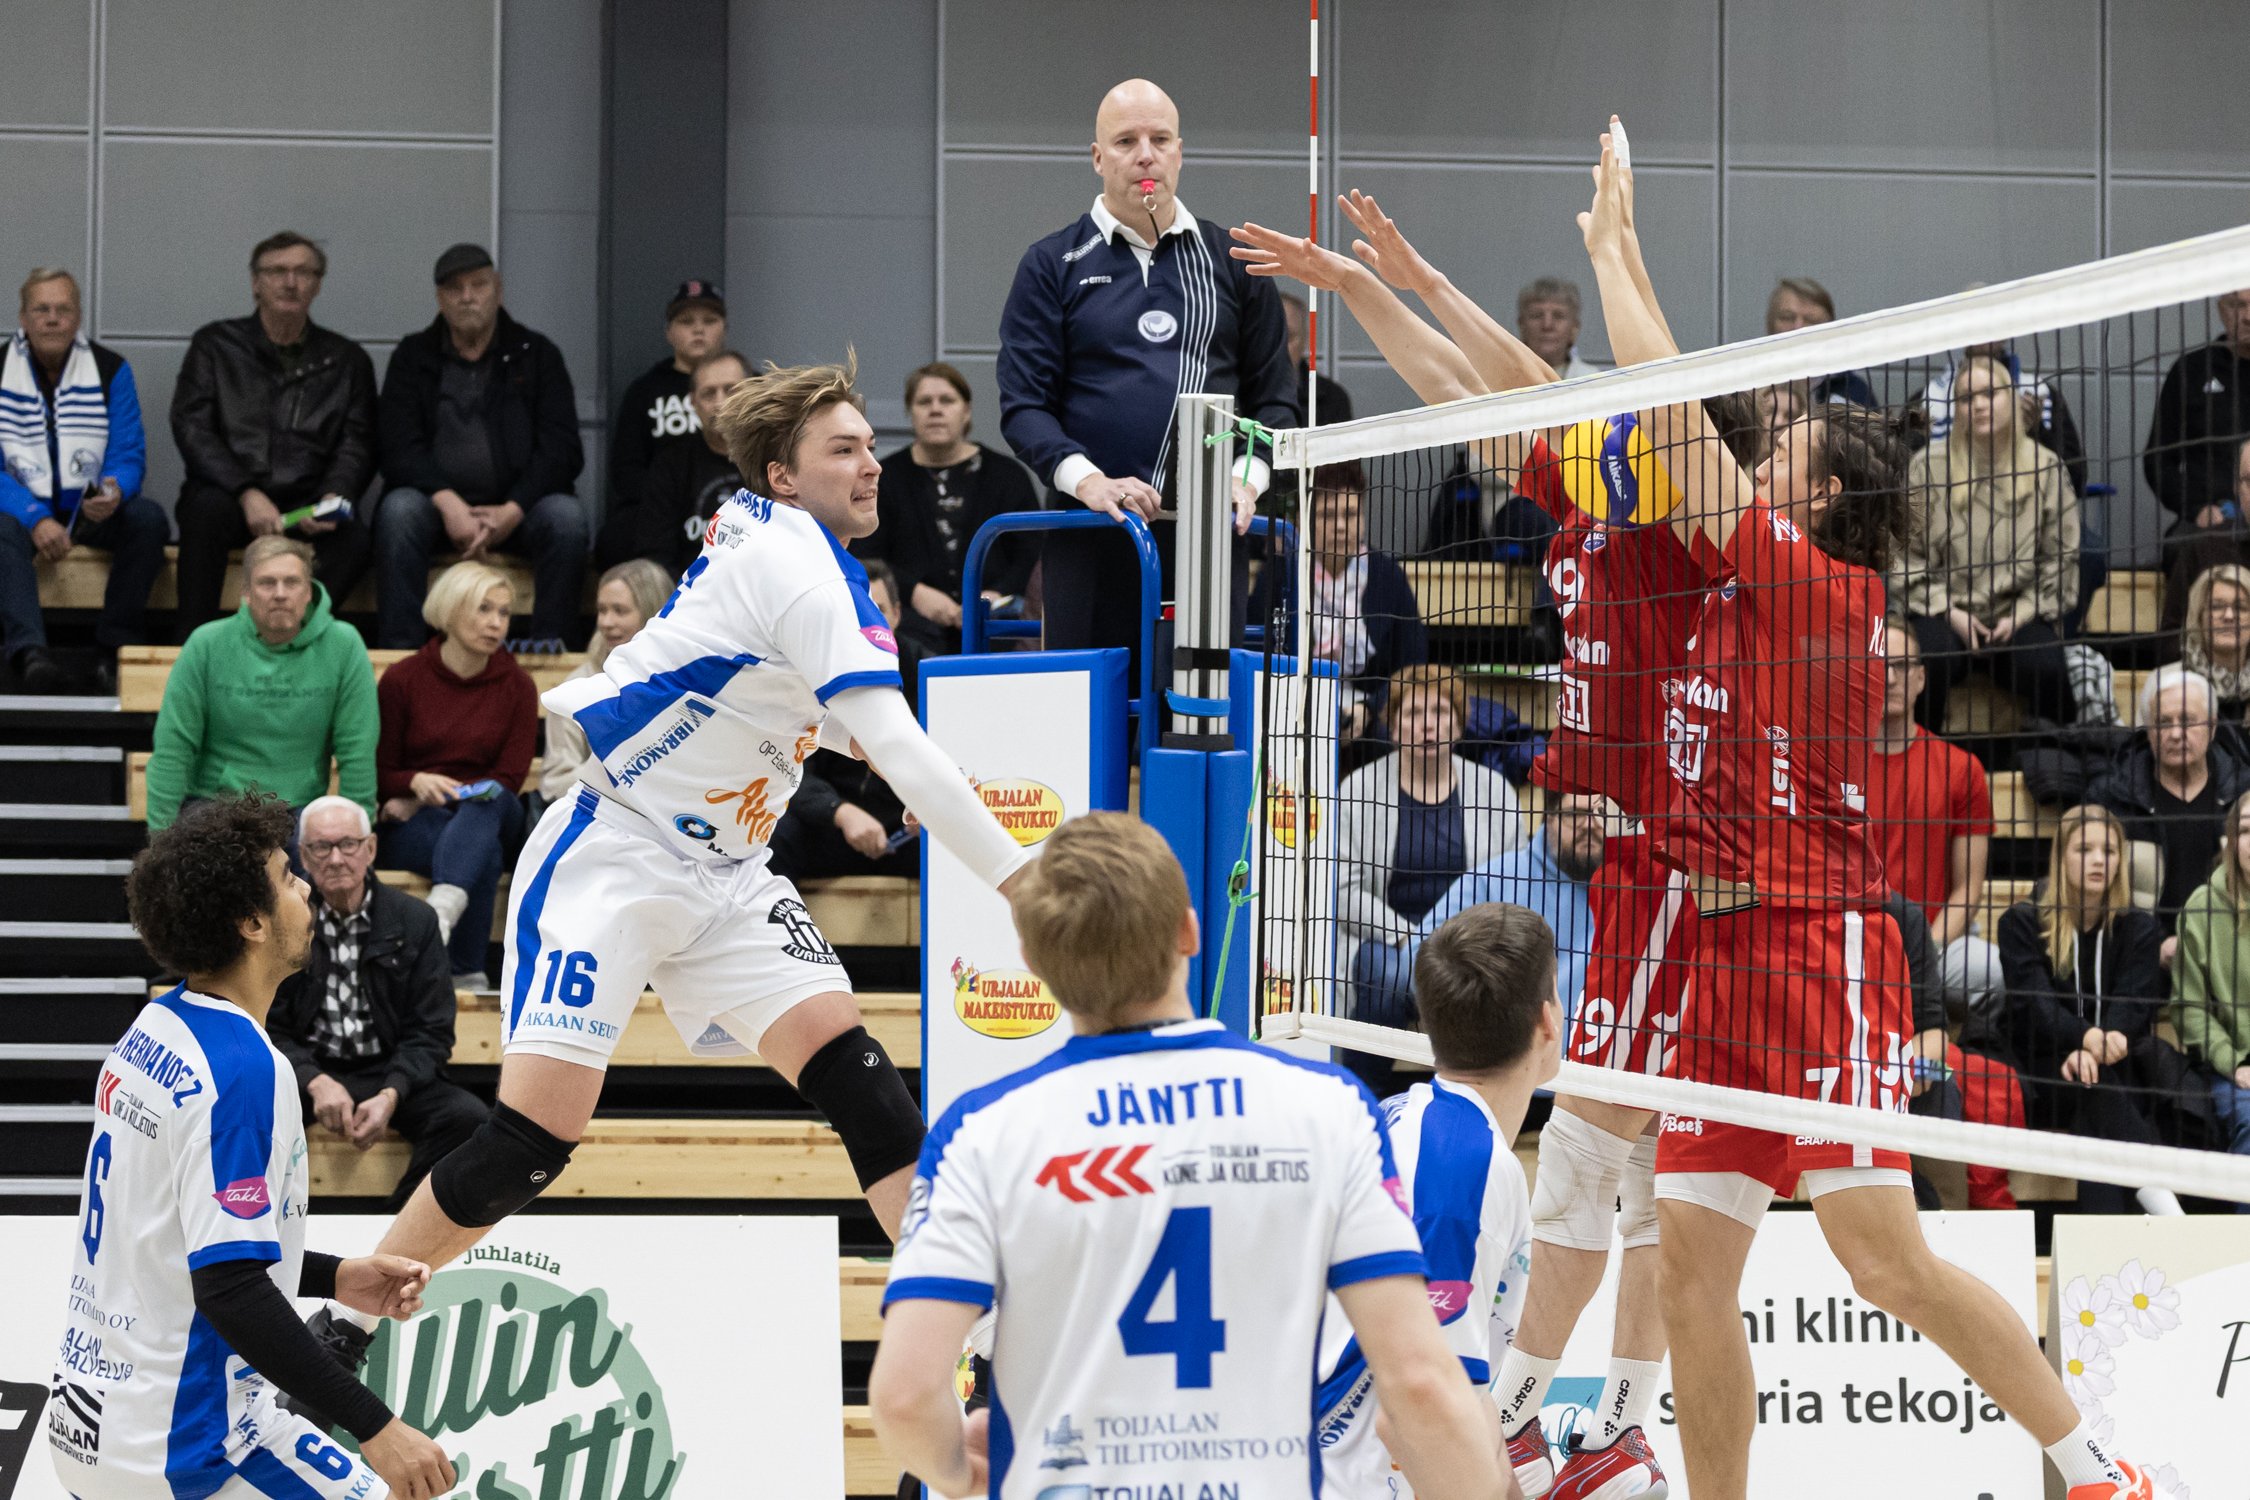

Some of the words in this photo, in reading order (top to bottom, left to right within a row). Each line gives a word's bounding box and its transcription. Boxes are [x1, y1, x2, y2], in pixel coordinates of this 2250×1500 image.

[652, 412, 703, 438] JON
[619, 698, 716, 789] VIBRAKONE
[984, 789, 1043, 808] URJALAN
[993, 810, 1058, 829] ISTUKKU
[541, 950, 598, 1008] 16
[981, 980, 1041, 998] URJALAN
[523, 1012, 585, 1032] AKAAN
[963, 1001, 1056, 1020] MAKEISTUKKU
[1087, 1077, 1245, 1128] JÄNTTI
[1206, 1162, 1229, 1183] JA
[1231, 1160, 1311, 1184] KULJETUS
[82, 1130, 112, 1266] 6
[463, 1245, 562, 1275] juhlatila
[1117, 1206, 1226, 1389] 4
[109, 1313, 137, 1332] OY
[1510, 1375, 1537, 1412] CRAFT
[1612, 1379, 1631, 1421] CRAFT
[1095, 1412, 1220, 1439] TOIJALAN
[294, 1432, 354, 1481] 6
[1095, 1437, 1270, 1467] TILITOIMISTO
[2086, 1439, 2112, 1469] CRAFT
